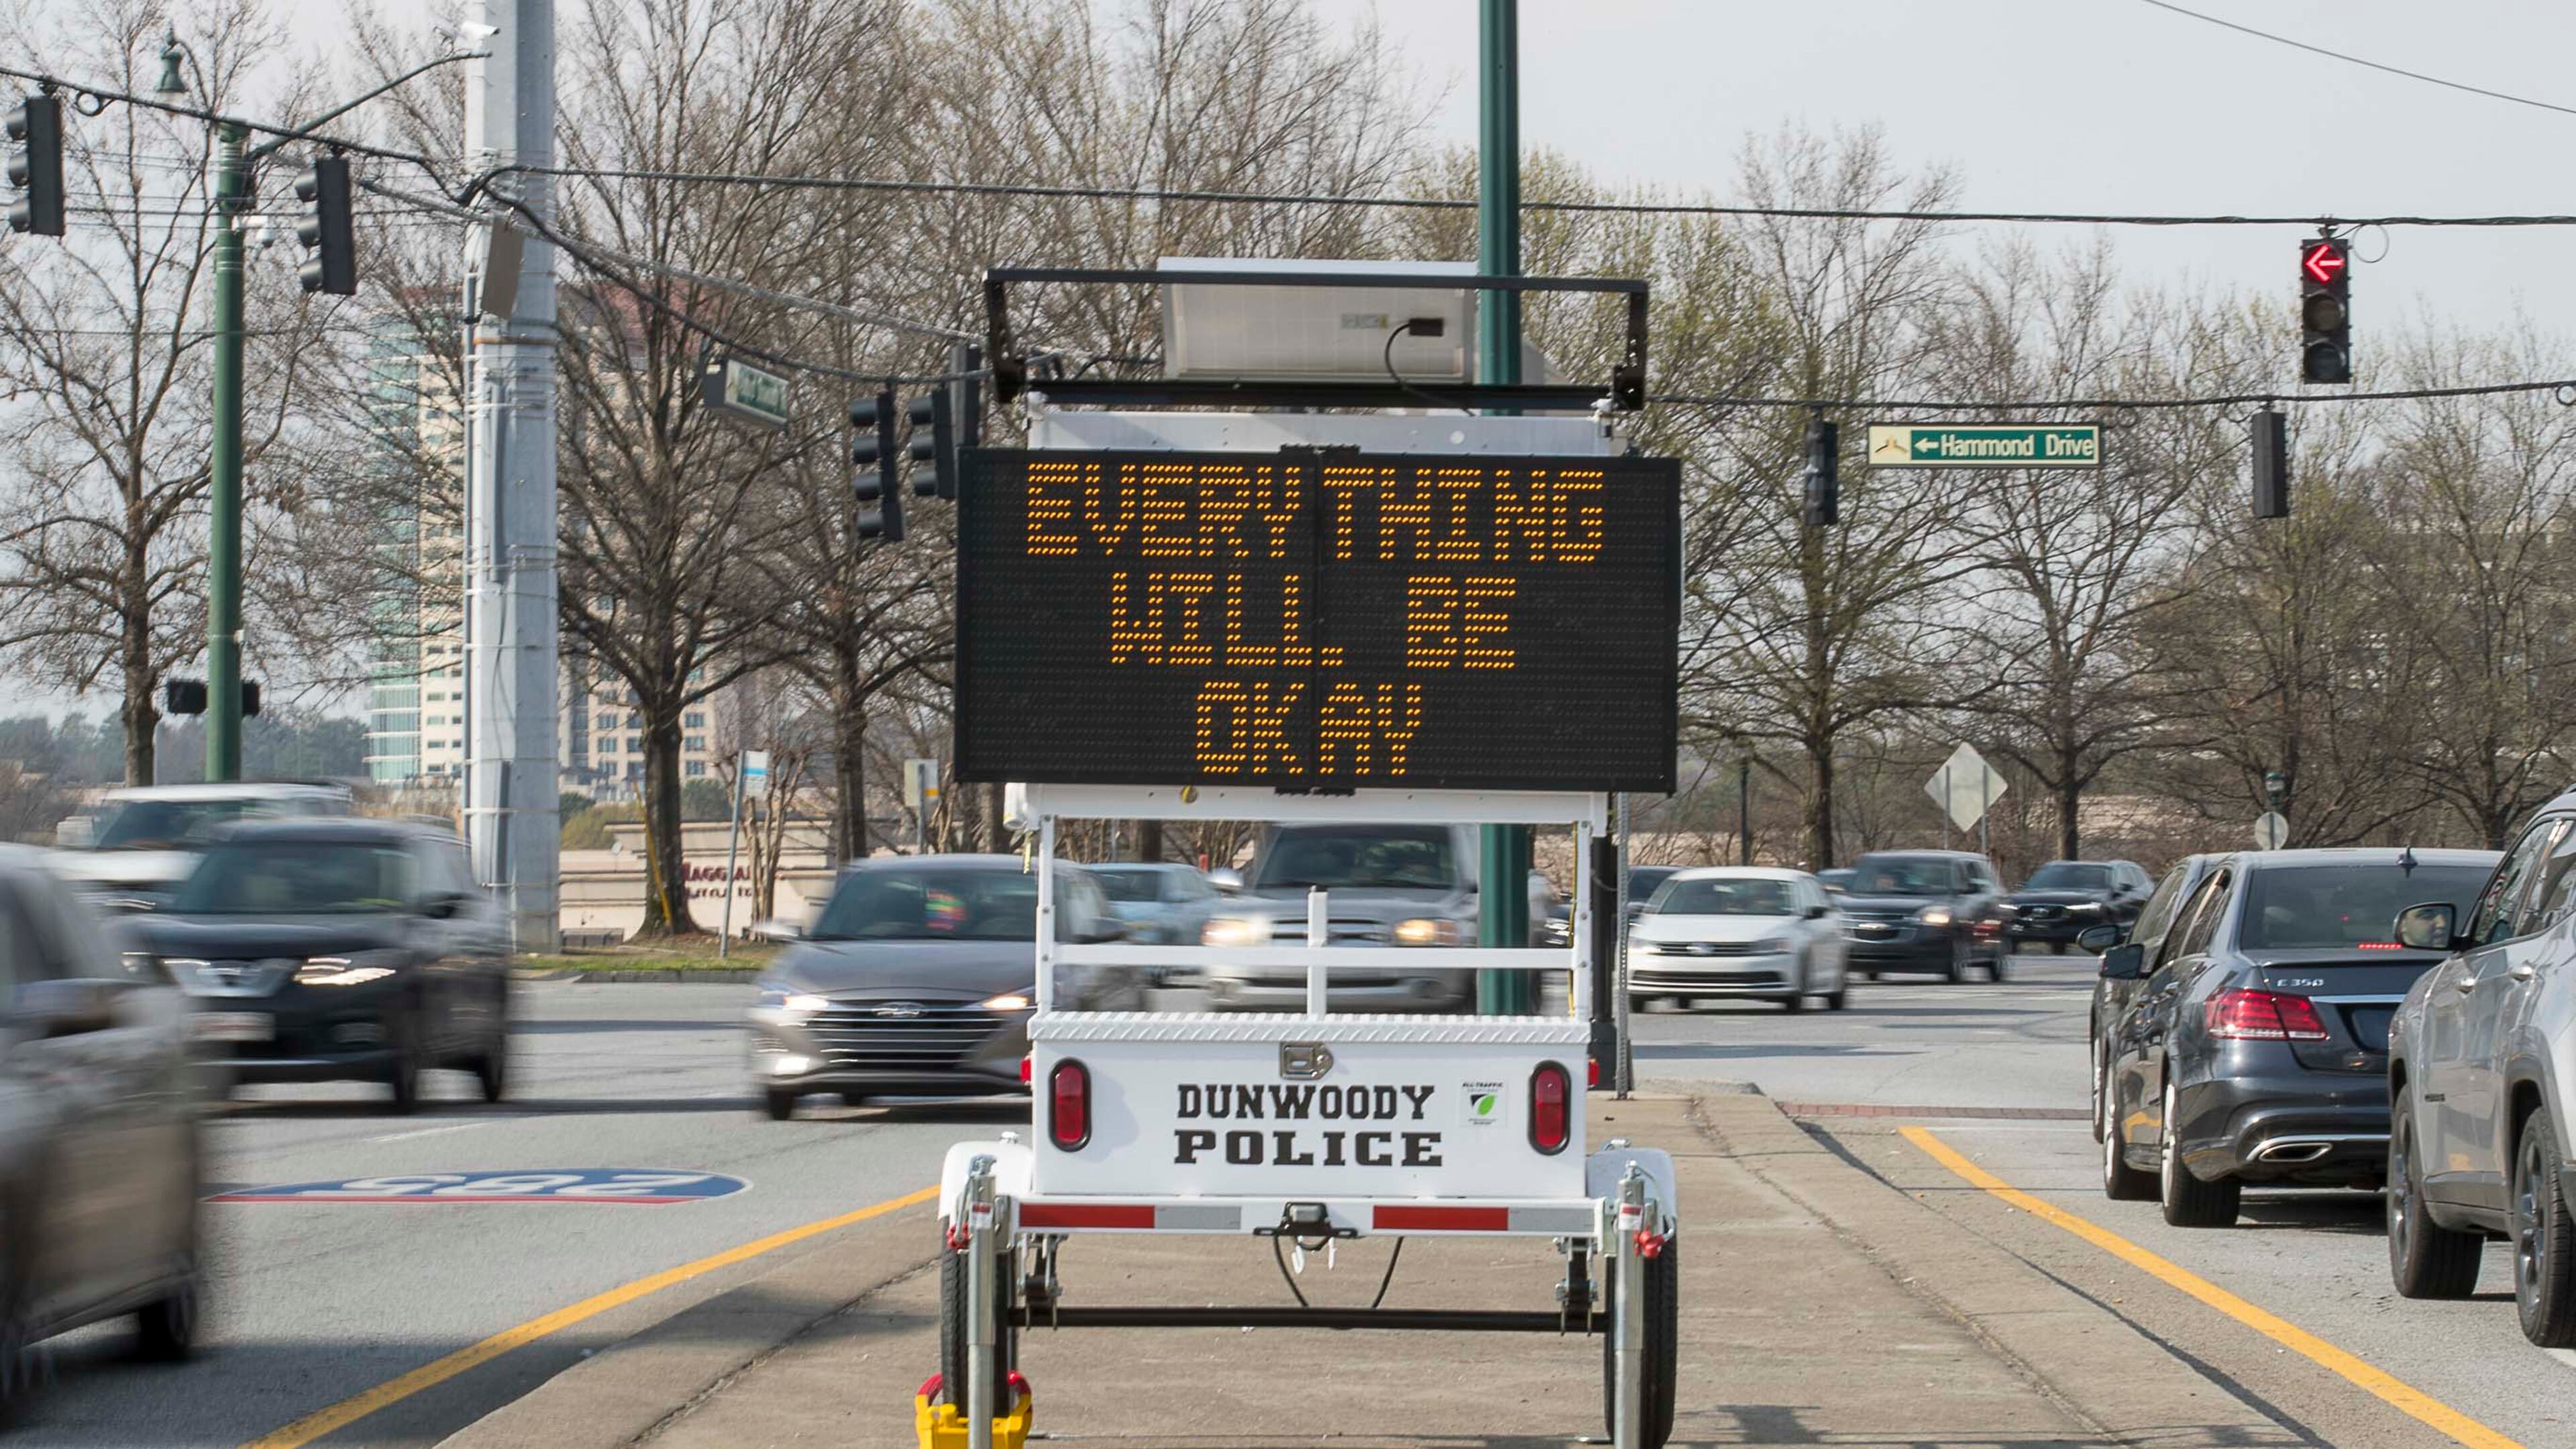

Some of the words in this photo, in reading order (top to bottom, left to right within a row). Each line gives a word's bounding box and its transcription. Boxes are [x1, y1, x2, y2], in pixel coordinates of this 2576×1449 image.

[1941, 433, 2035, 456] Hammond
[2045, 433, 2094, 456] Drive
[1026, 463, 1604, 562] EVERYTHING
[1110, 572, 1344, 667] WILL
[1406, 576, 1516, 669] BE
[1195, 681, 1421, 775] OKAY
[1177, 1083, 1435, 1120] DUNWOODY
[1173, 1129, 1443, 1167] POLICE
